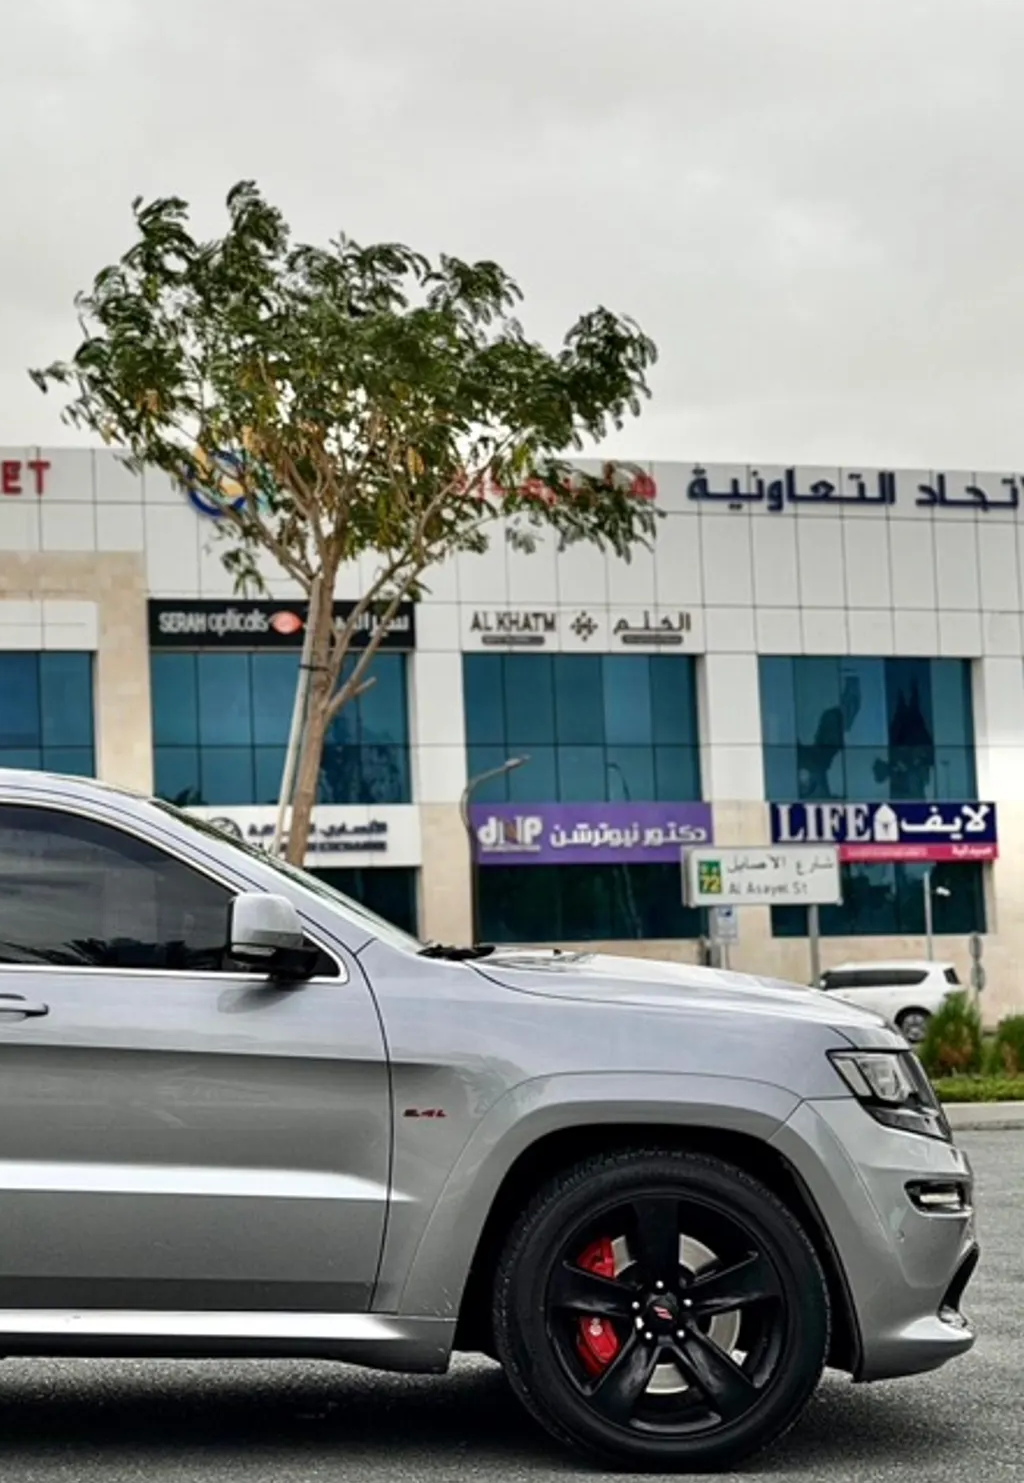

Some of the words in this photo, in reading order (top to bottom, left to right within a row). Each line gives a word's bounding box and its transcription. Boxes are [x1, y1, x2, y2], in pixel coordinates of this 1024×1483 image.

[687, 467, 895, 513] التعاونية
[470, 611, 493, 632] AL
[642, 822, 707, 847] دكتور
[777, 803, 871, 842] LIFE
[900, 805, 991, 841] لايف
[792, 882, 808, 895] St
